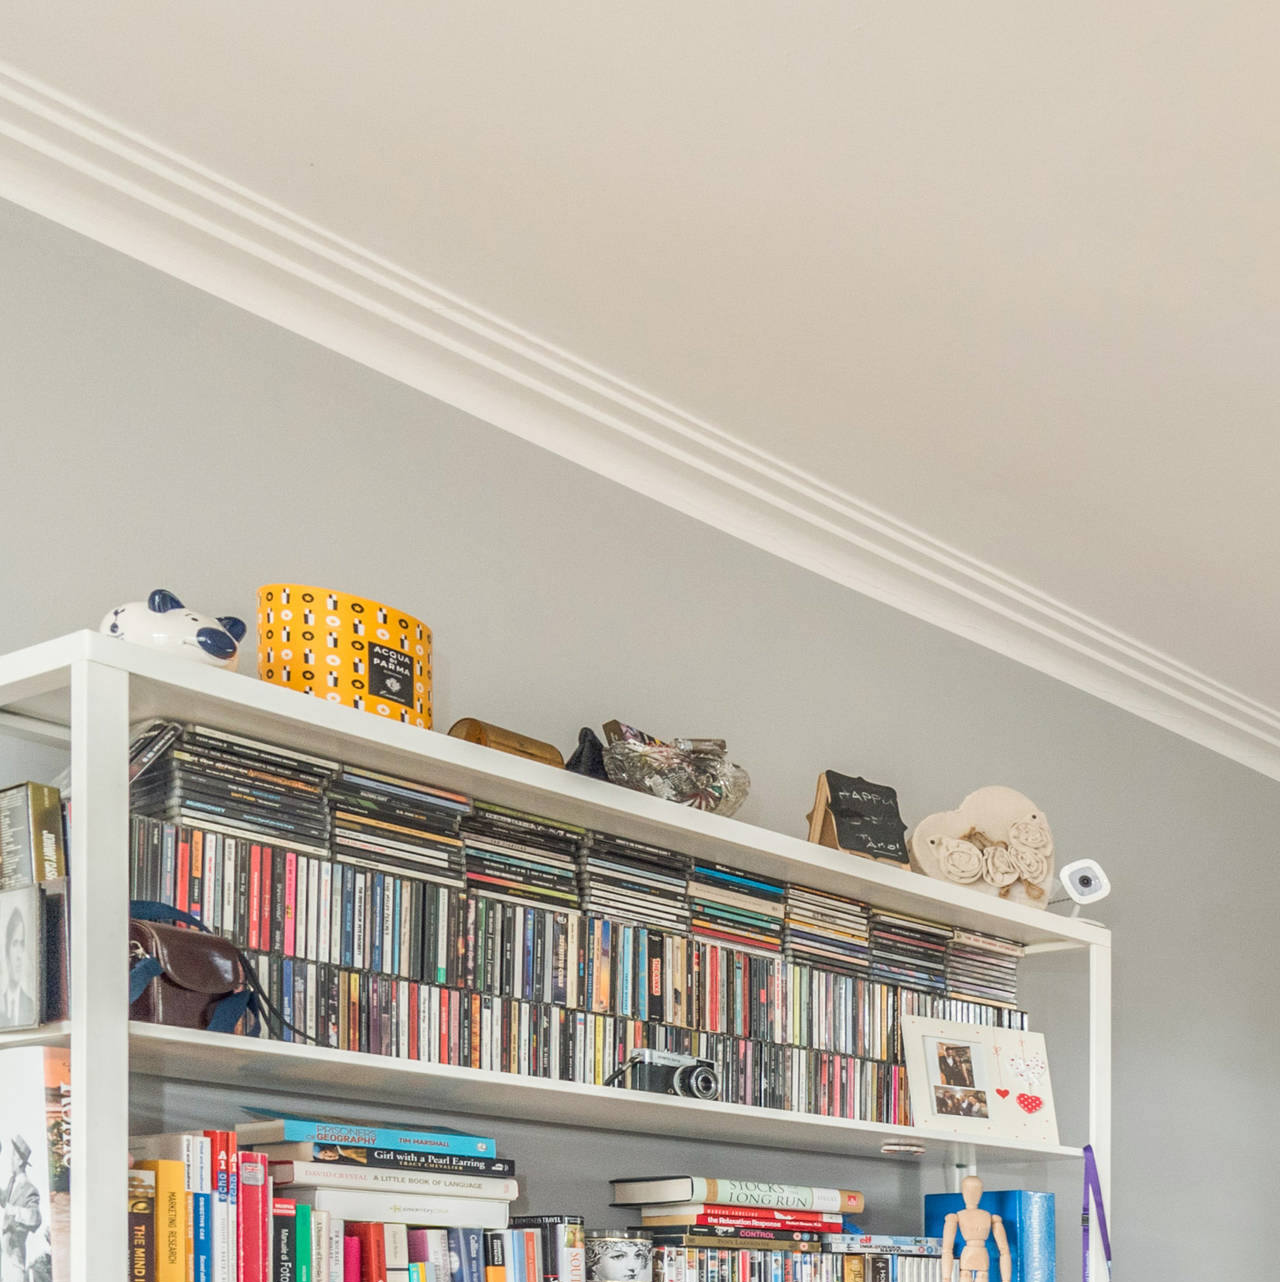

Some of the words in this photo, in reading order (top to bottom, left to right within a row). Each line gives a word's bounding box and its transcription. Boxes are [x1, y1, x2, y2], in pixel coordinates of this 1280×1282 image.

[374, 646, 410, 664] ACQUA
[374, 658, 410, 676] PARMA
[42, 830, 57, 862] JOHNNY
[316, 1125, 376, 1138] PRISONERS
[316, 1134, 376, 1145] GEOGRAPHY
[374, 1151, 393, 1161] Girl
[398, 1153, 418, 1162] with
[432, 1155, 454, 1166] Pearl
[458, 1158, 485, 1169] Earring
[382, 1176, 404, 1184] LITTLE
[409, 1178, 428, 1186] BOOK
[729, 1180, 784, 1193] STOCKS
[728, 1192, 771, 1205] LONG
[776, 1195, 807, 1208] RUN
[168, 1191, 177, 1228] MARKETING
[719, 1217, 751, 1226] Relaxation
[134, 1225, 146, 1246] THE
[280, 1228, 289, 1254] Manuale
[740, 1230, 775, 1239] CONTROL
[168, 1230, 177, 1264] RESEARCH
[470, 1234, 480, 1258] Collins
[134, 1248, 146, 1276] MIND
